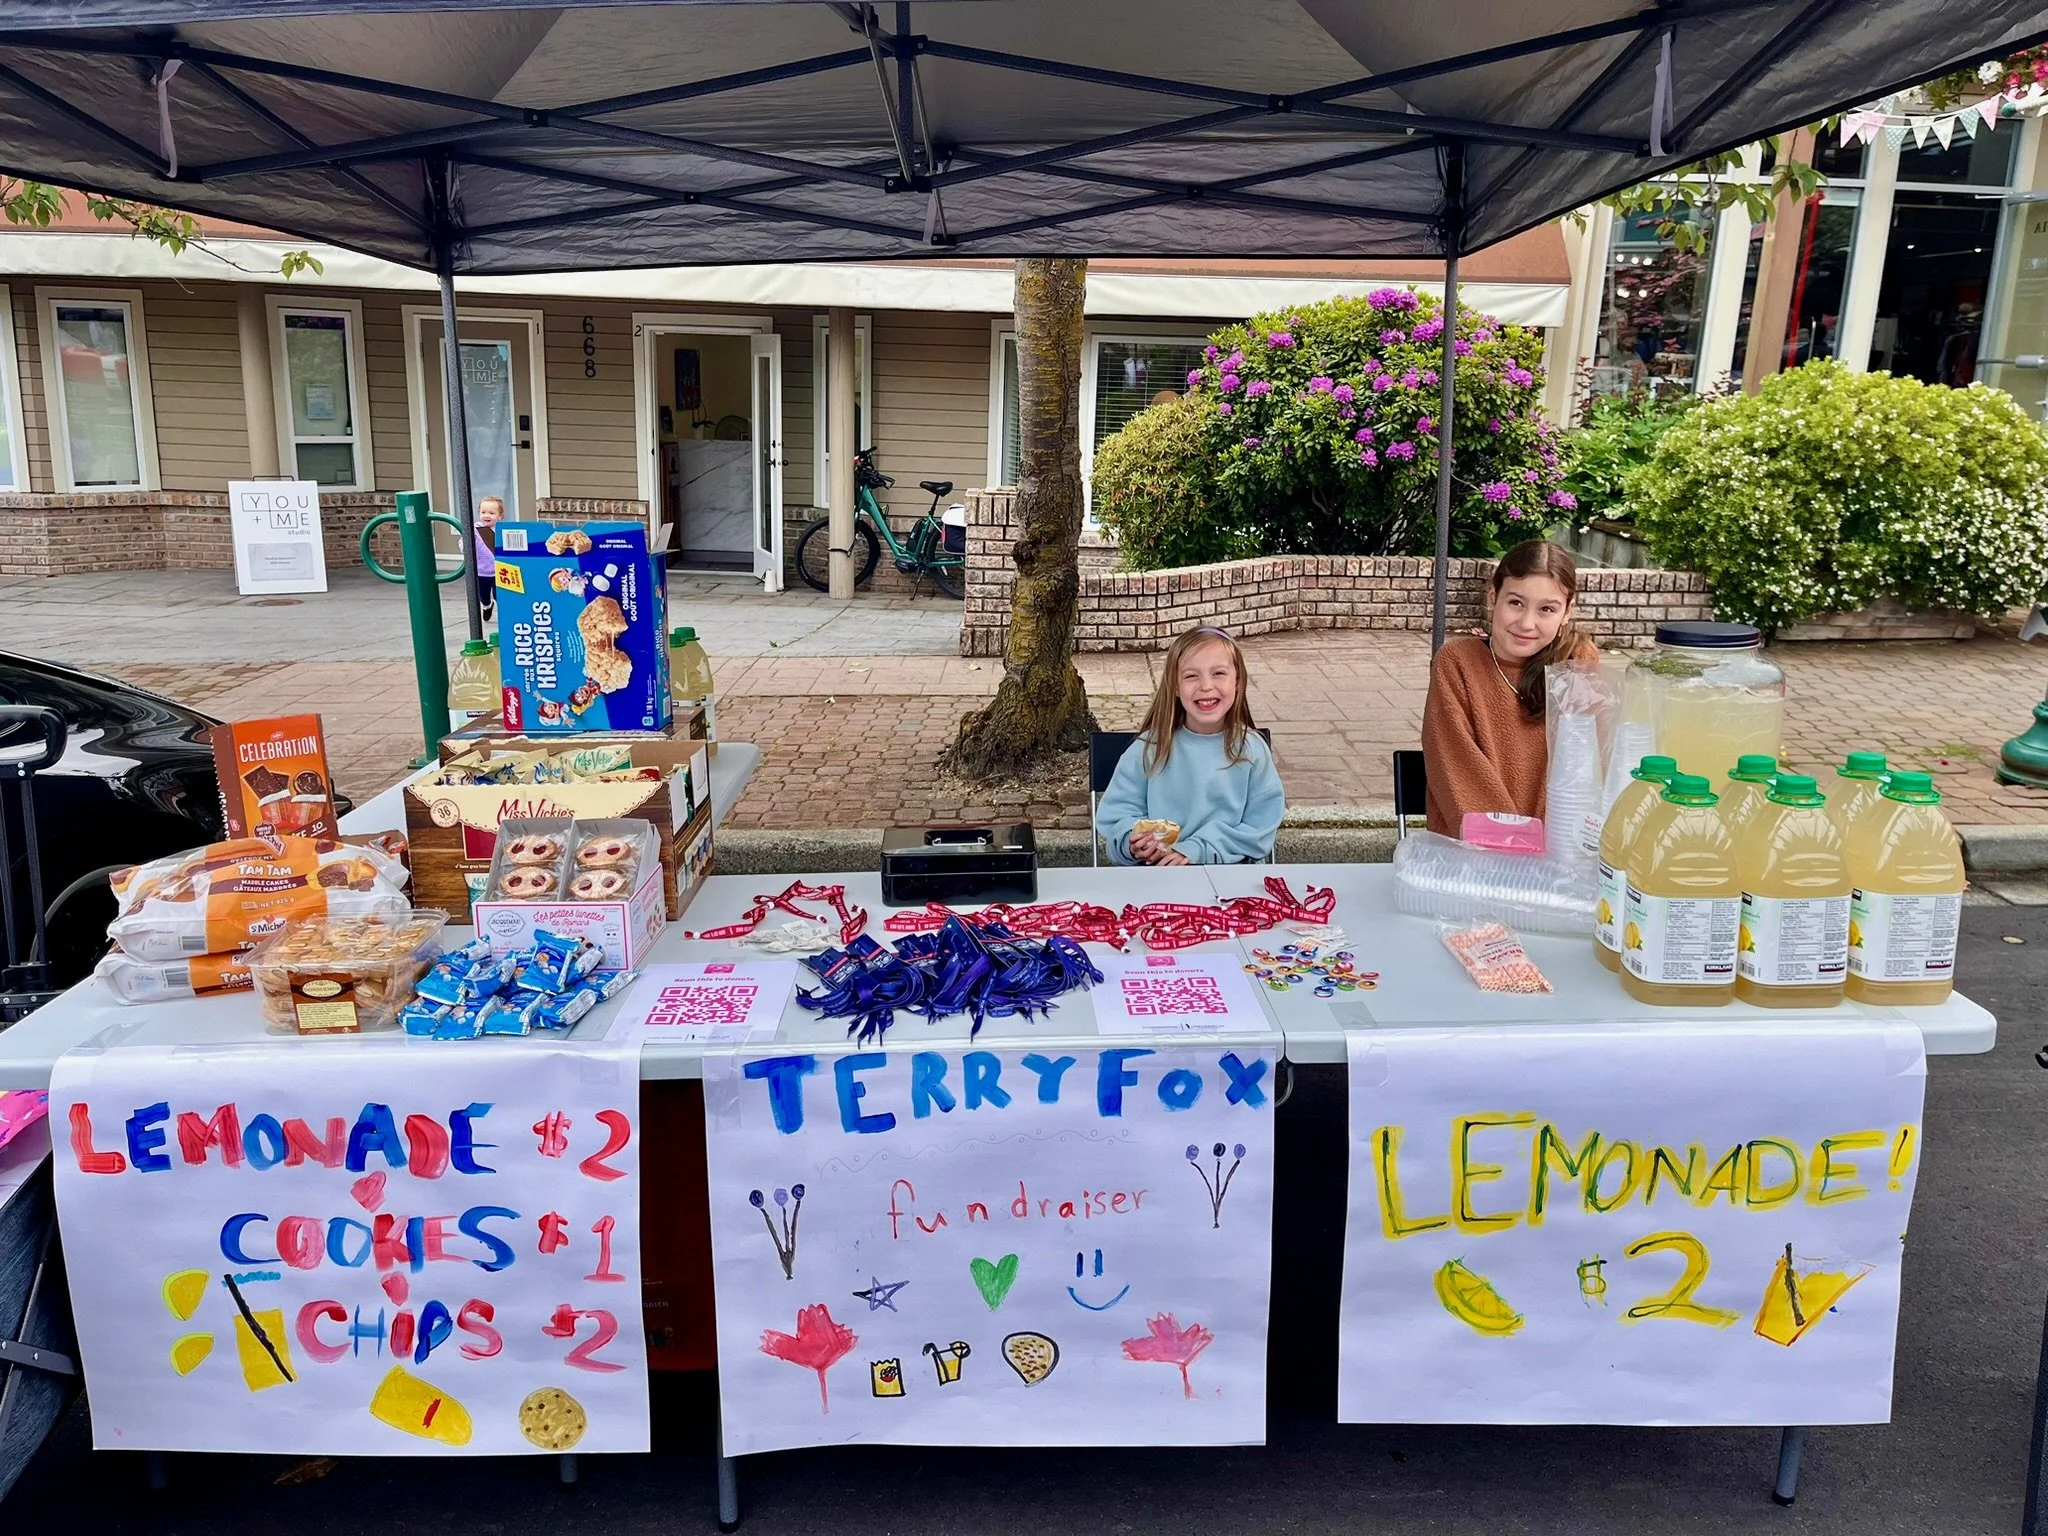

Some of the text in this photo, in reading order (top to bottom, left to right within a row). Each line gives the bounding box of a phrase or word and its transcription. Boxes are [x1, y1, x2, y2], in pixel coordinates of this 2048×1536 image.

[634, 325, 642, 337] 2
[582, 316, 596, 378] 668
[250, 495, 309, 509] YOU
[277, 513, 310, 526] ME
[498, 567, 511, 585] 54
[621, 574, 630, 610] ORIGINAL
[629, 562, 638, 622] GOÛT ORIGINAL
[506, 688, 519, 725] Kellogg's
[239, 735, 318, 763] CELEBRATION
[437, 805, 451, 818] 36
[497, 799, 575, 826] Miss Vickie's
[311, 821, 324, 833] 10
[238, 863, 293, 876] TAM TAM
[233, 884, 262, 892] GÂTEAUX
[533, 910, 548, 923] Les
[549, 909, 574, 922] petites
[574, 908, 606, 922] lunettes
[551, 918, 560, 927] de
[742, 1051, 1078, 1136] TERRY
[68, 1101, 498, 1181] LEMONADE
[219, 1205, 522, 1274] COOKIES
[295, 1297, 505, 1365] CHIPS
